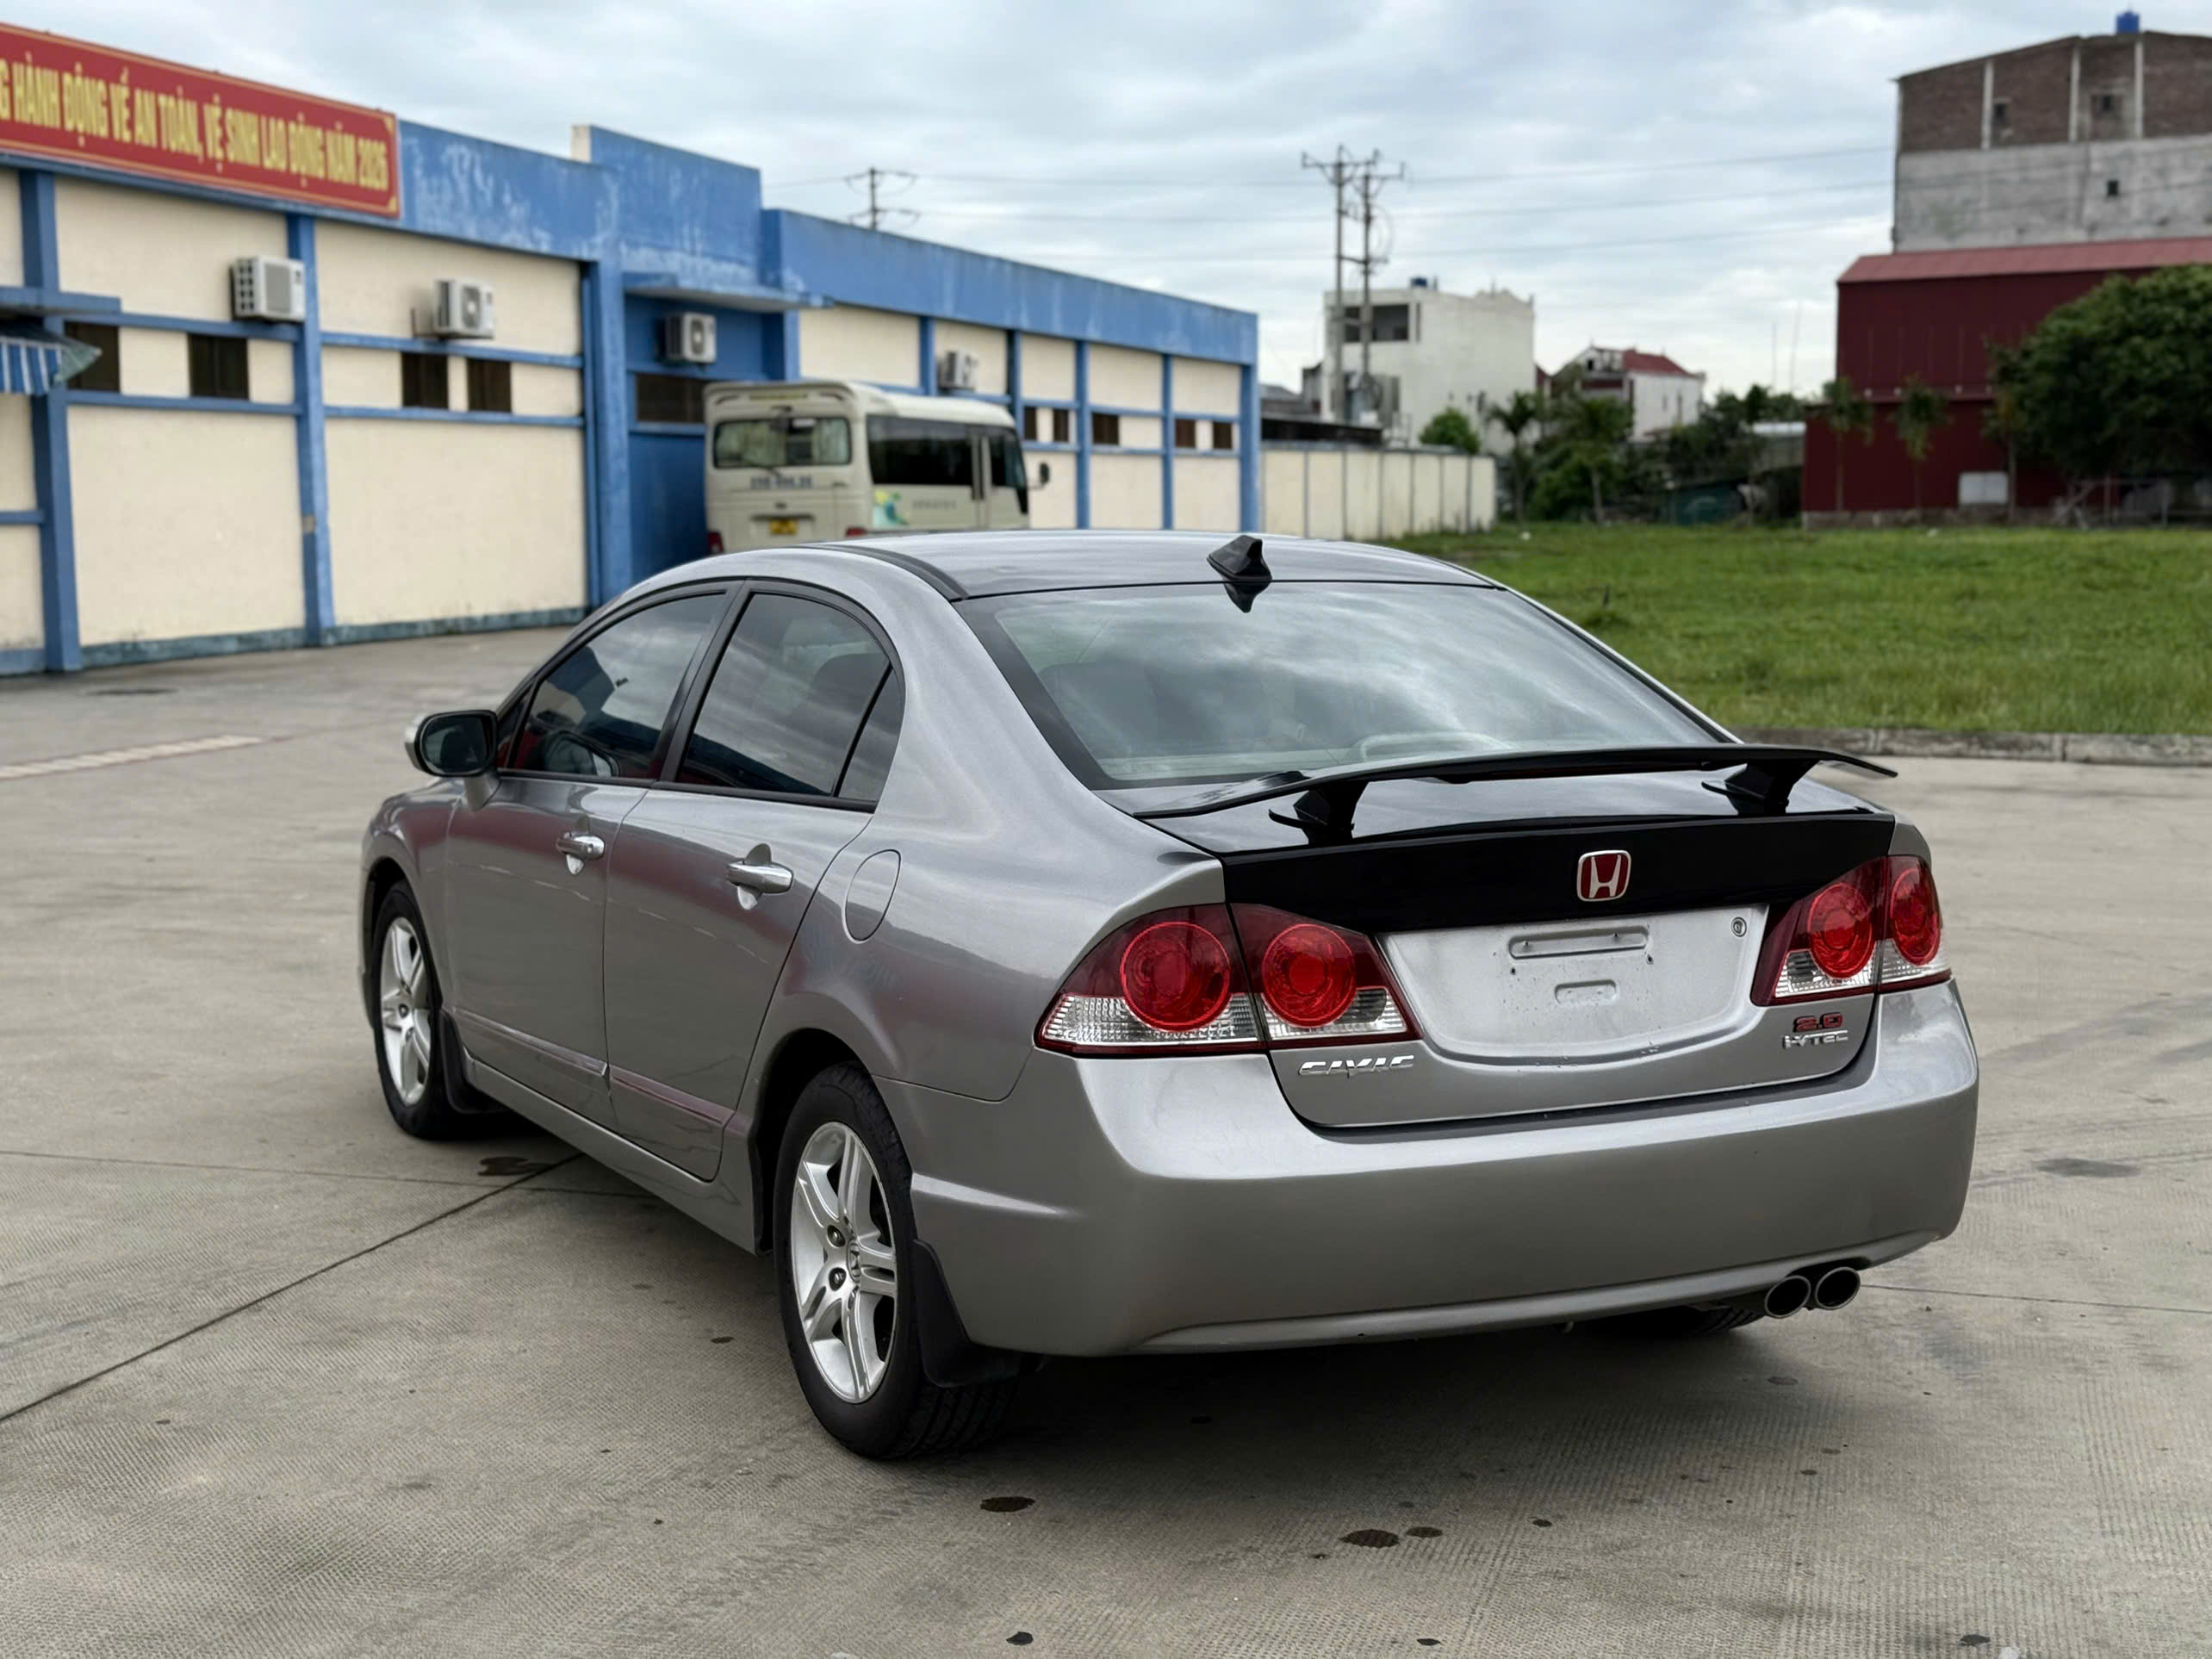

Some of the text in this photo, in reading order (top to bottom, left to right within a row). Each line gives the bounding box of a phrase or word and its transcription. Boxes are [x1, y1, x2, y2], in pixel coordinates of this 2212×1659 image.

[63, 61, 109, 146] ĐỘNG
[134, 87, 157, 147] AN
[203, 93, 224, 173] VỆ
[226, 108, 260, 167] SINH
[261, 114, 287, 171] LAO
[289, 110, 325, 187] ĐỘNG
[1793, 1012, 1843, 1032] 2.0
[1298, 1055, 1414, 1075] CIVIC
